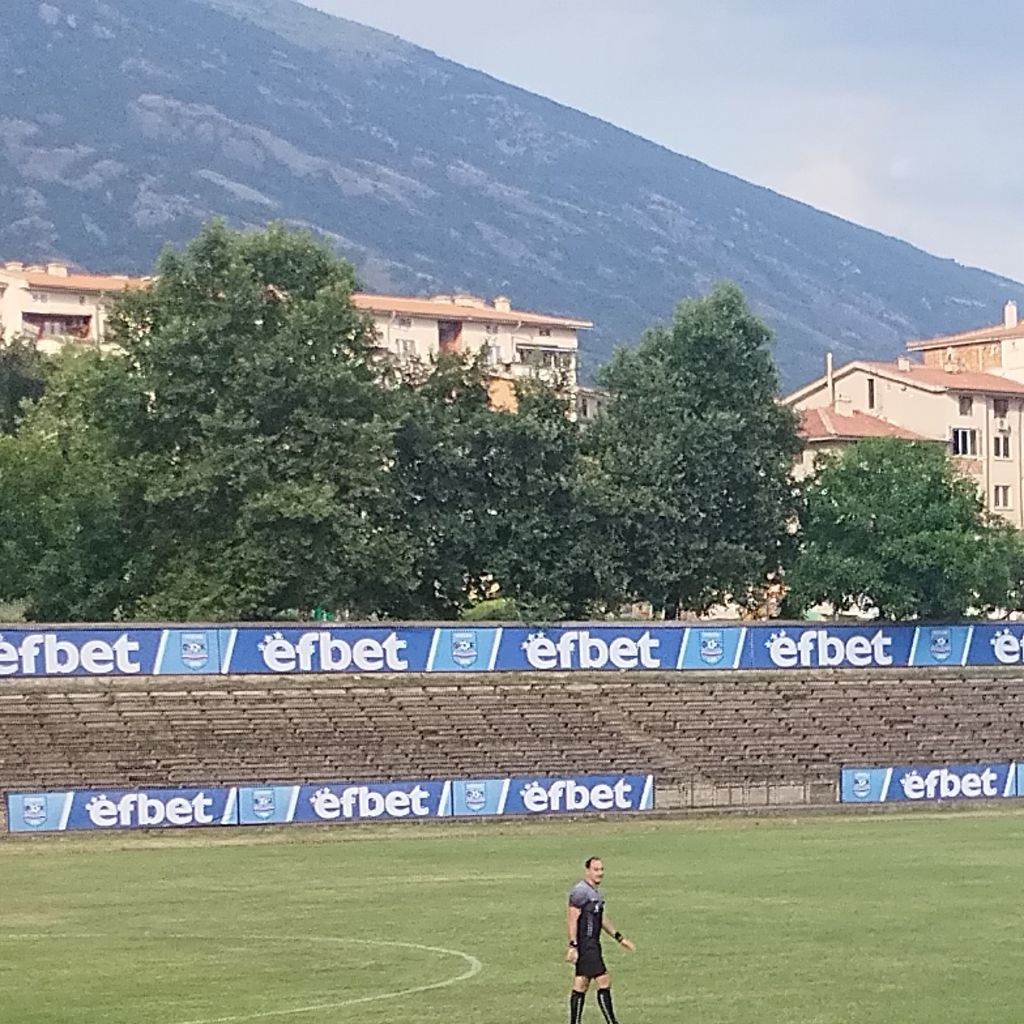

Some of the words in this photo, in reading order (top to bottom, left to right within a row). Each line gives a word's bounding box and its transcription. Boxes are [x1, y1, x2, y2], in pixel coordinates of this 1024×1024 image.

[0, 633, 140, 674] efbet
[263, 632, 408, 672] efbet
[527, 630, 660, 669] efbet
[769, 629, 893, 667] efbet
[523, 778, 631, 812] efbet
[904, 768, 998, 799] efbet
[90, 792, 214, 826] efbet
[315, 785, 429, 819] efbet
